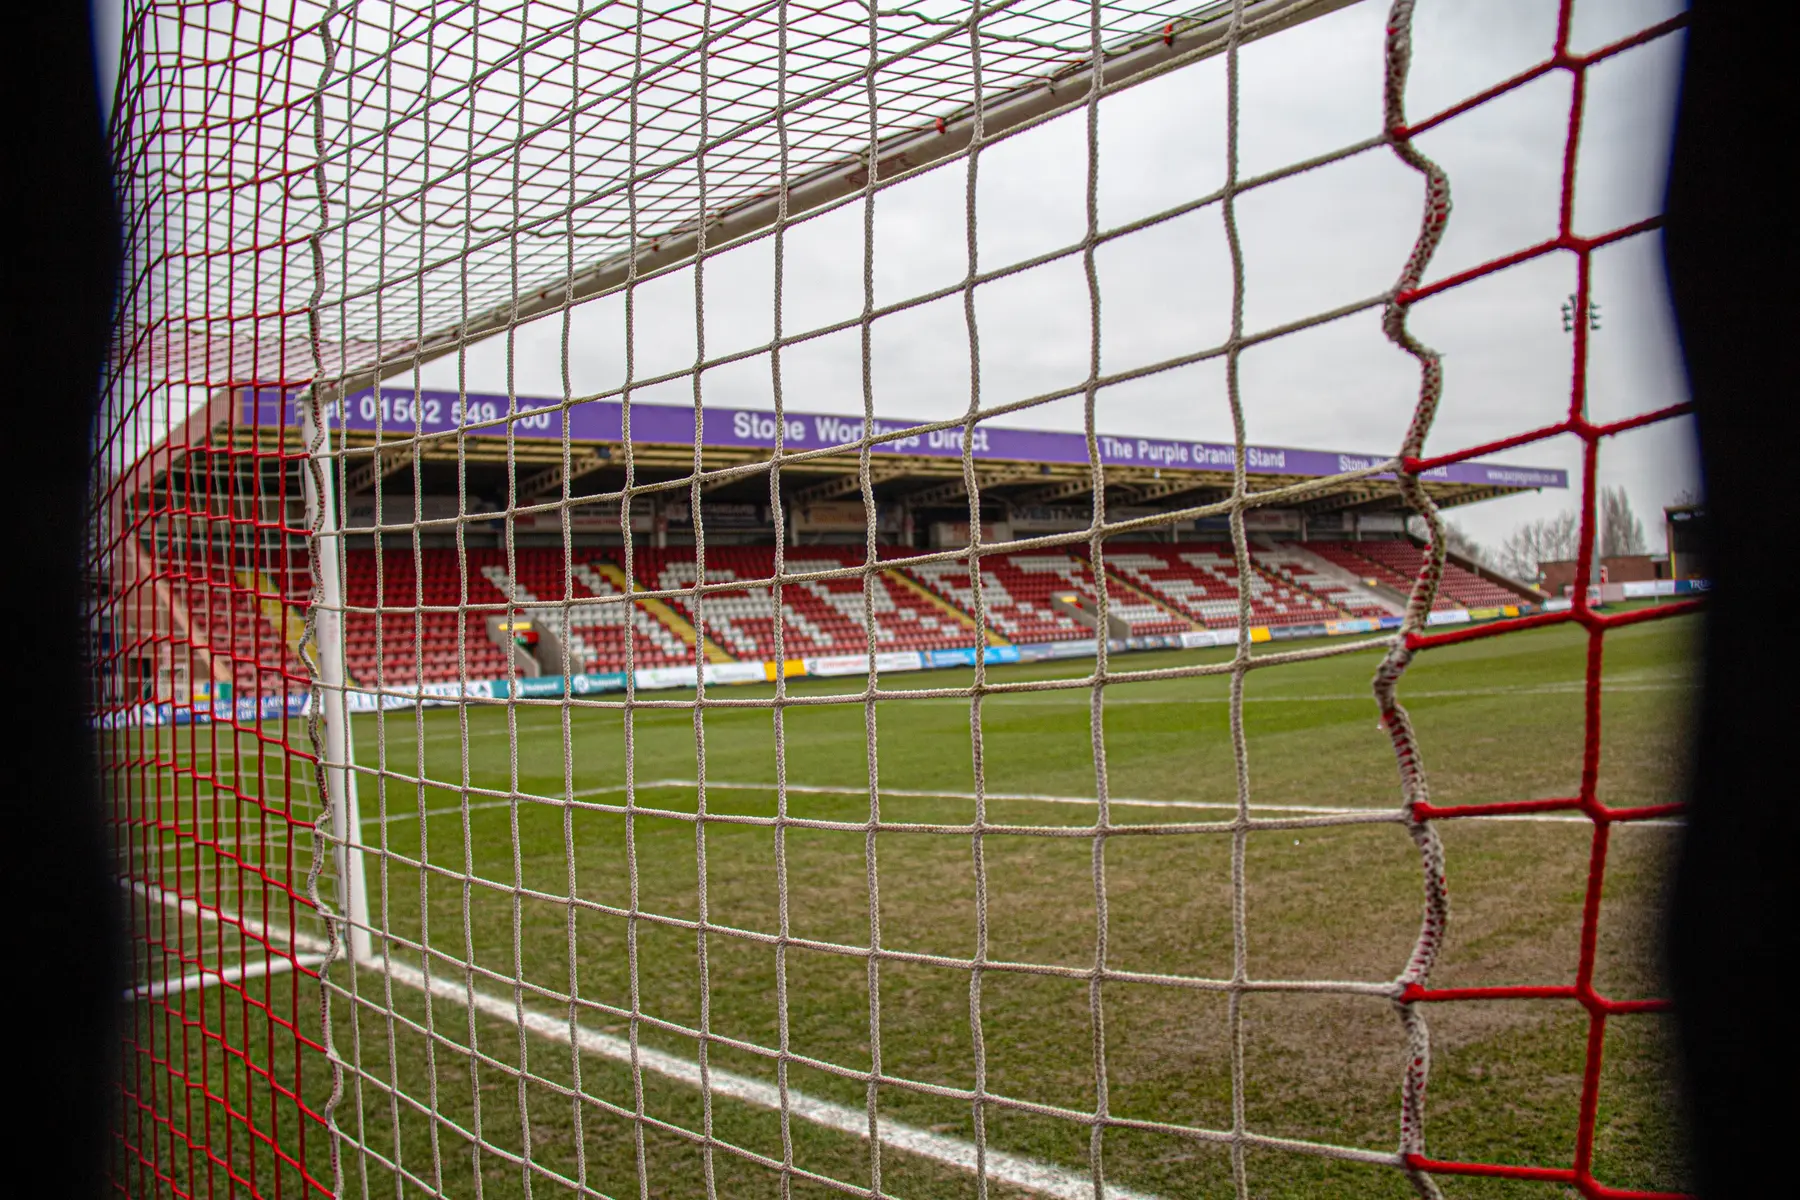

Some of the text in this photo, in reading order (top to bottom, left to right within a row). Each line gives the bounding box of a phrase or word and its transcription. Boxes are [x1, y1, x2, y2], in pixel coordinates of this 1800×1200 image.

[360, 396, 441, 424] 01562
[451, 401, 497, 425] 549
[733, 411, 805, 441] Stone
[1102, 437, 1286, 468] The Purple Granit Stand
